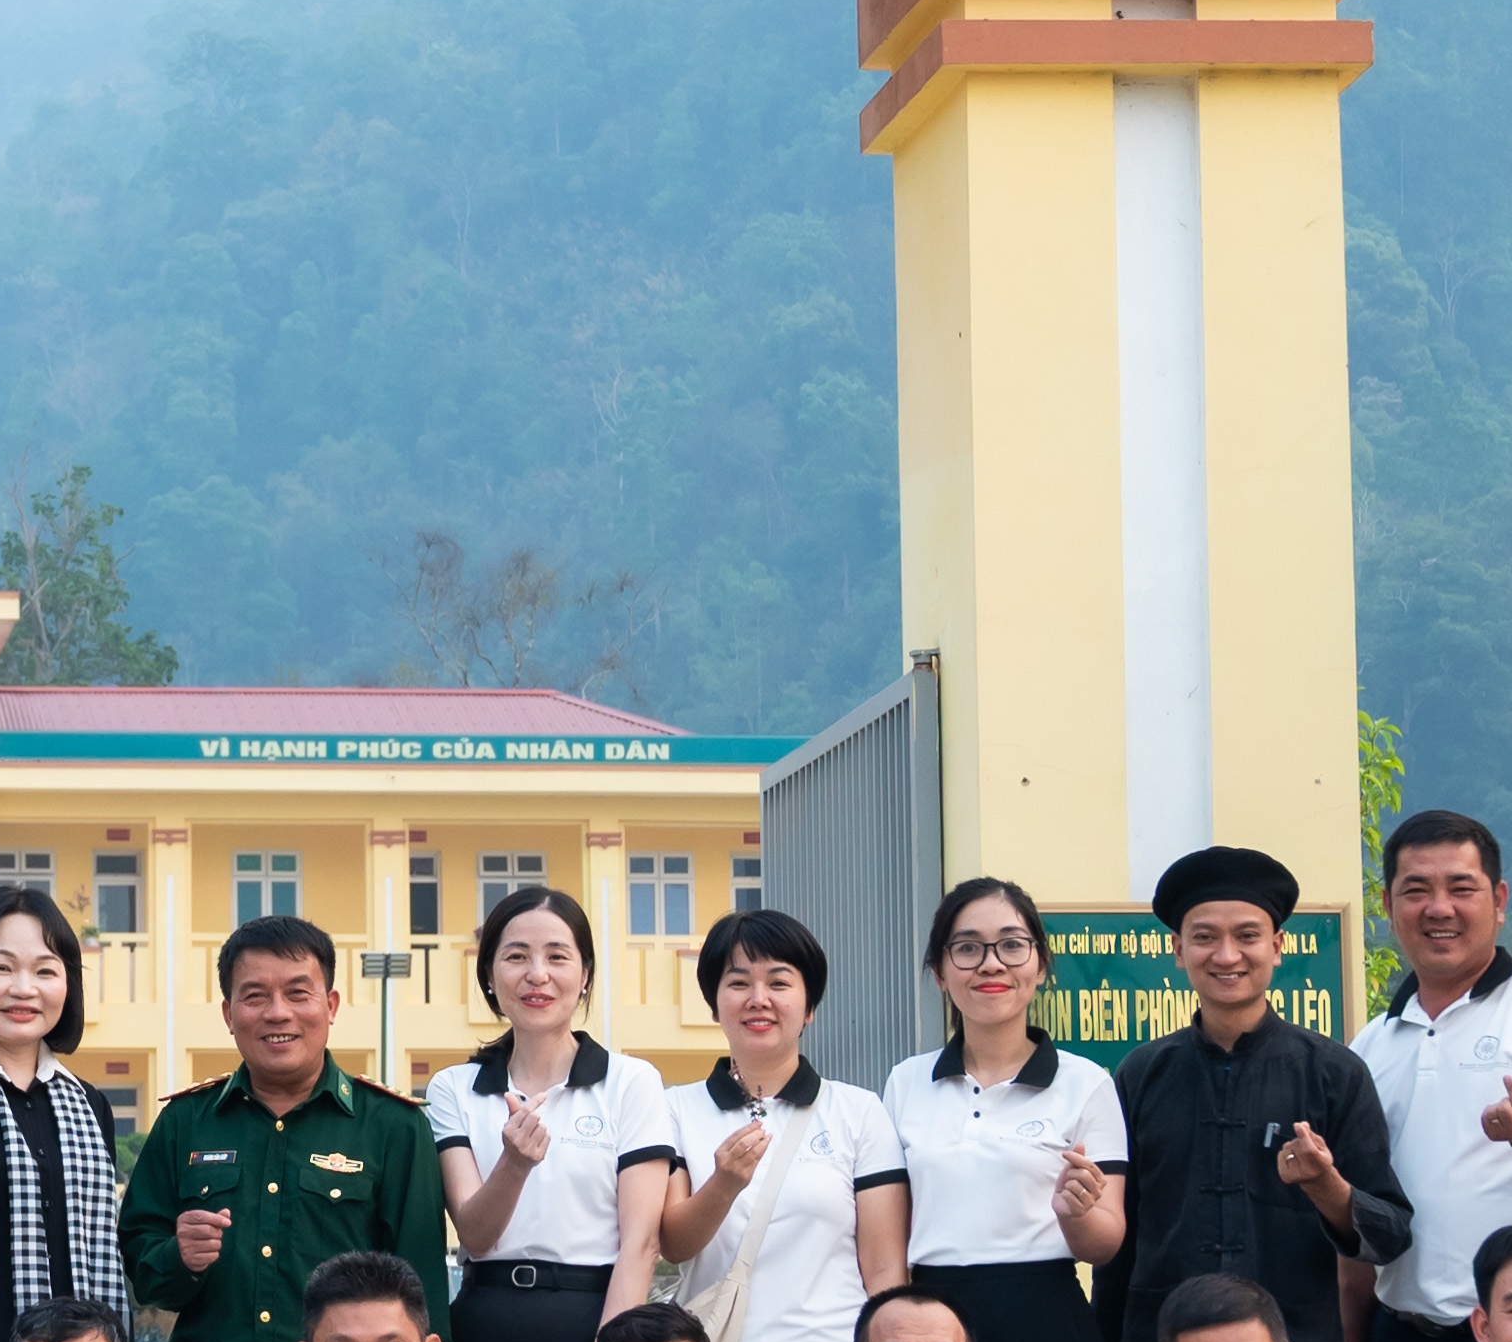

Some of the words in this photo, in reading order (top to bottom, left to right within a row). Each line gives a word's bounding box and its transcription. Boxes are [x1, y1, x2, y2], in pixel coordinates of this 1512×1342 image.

[199, 737, 230, 757] VÌ
[240, 740, 327, 761] HẠNH
[337, 737, 422, 759] PHÚC
[432, 737, 495, 759] CỦA
[506, 740, 594, 760] NHÂN
[605, 740, 670, 761] DÂN
[1048, 934, 1066, 954] AN
[1069, 926, 1090, 955] CHỈ
[1092, 934, 1116, 954] HUY
[1121, 929, 1138, 958] BỘ
[1141, 929, 1162, 958] ĐỘI
[1281, 931, 1298, 954] ƠN
[1301, 933, 1318, 954] LA
[1078, 978, 1128, 1041] BIÊN
